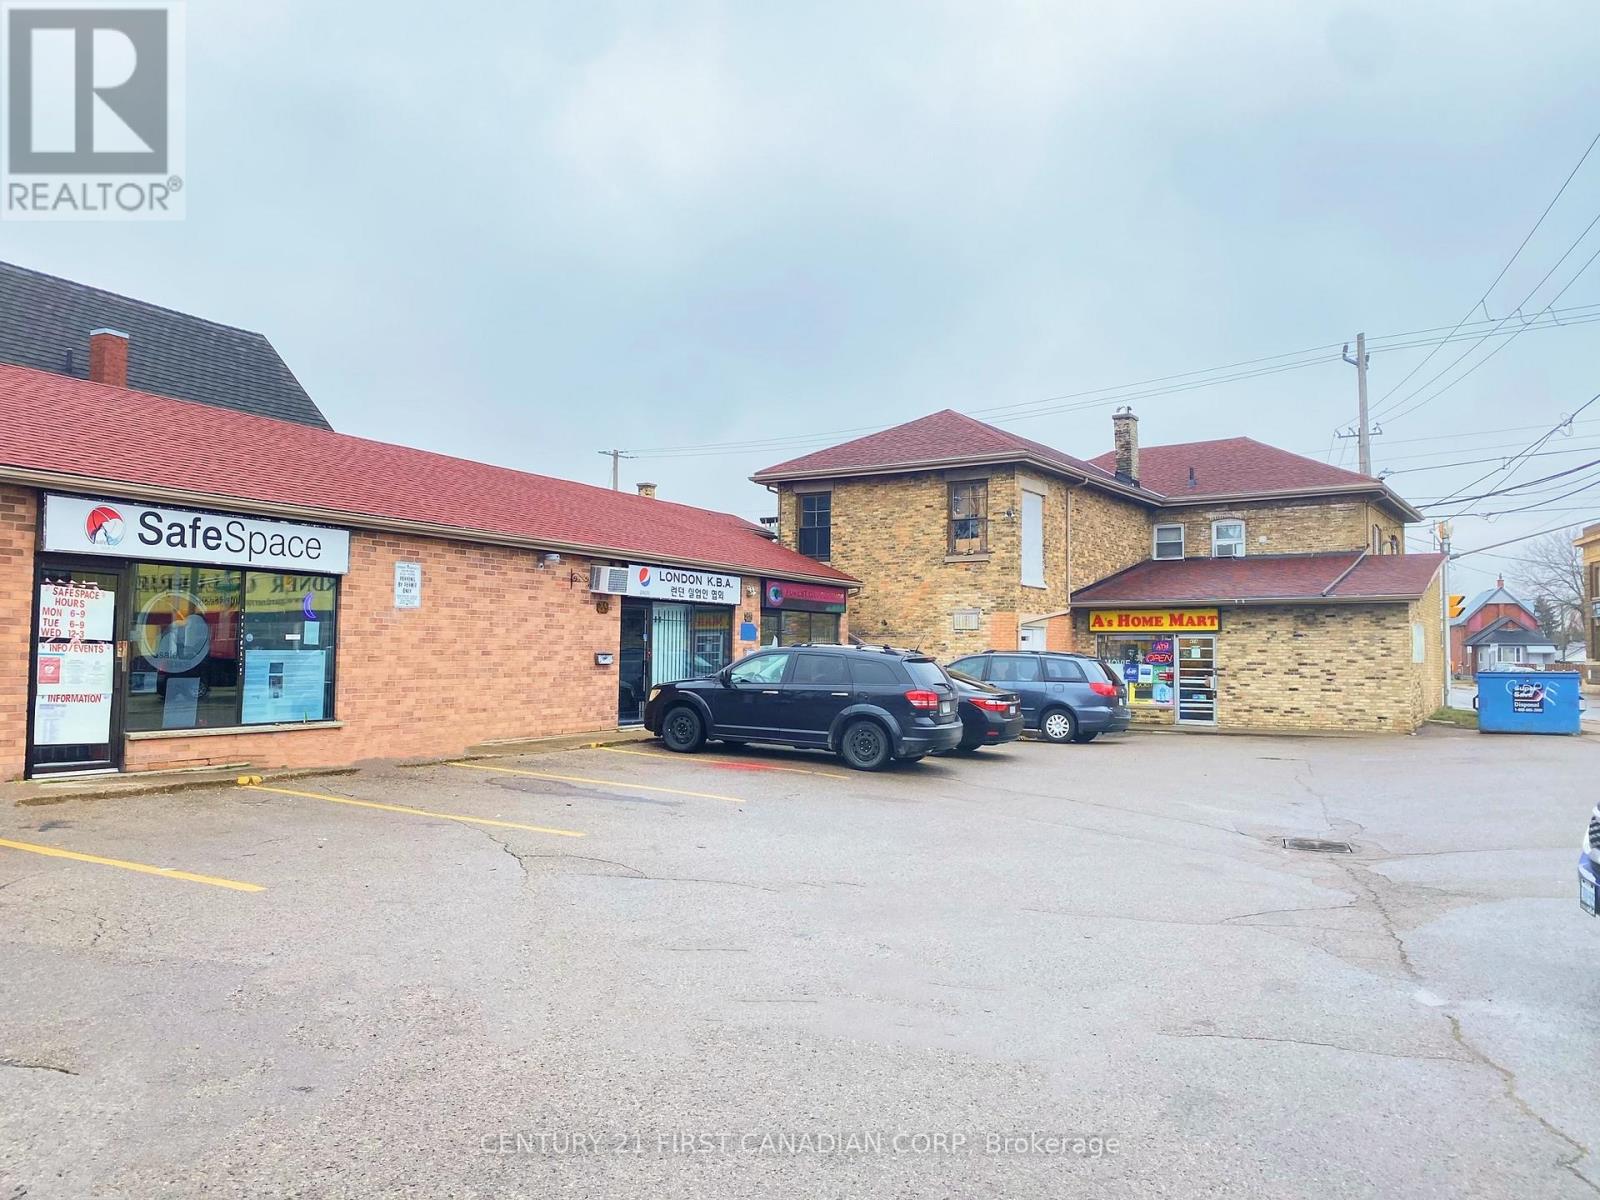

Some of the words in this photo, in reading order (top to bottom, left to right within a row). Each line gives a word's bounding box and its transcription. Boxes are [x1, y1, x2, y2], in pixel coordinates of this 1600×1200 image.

[138, 511, 321, 562] SafeSpace
[659, 571, 703, 585] LONDON
[707, 576, 734, 588] K.B.A.
[52, 586, 100, 600] SAFESPACE
[54, 597, 85, 608] HOURS
[42, 607, 62, 617] MON
[70, 610, 85, 618] 6-9
[43, 618, 59, 627] TUE
[69, 620, 85, 629] 6-9
[1117, 614, 1164, 627] HOME
[1168, 613, 1218, 627] MART
[41, 628, 61, 637] WED
[68, 630, 85, 638] 12-3
[1146, 654, 1173, 662] OPEN
[47, 694, 102, 703] INFORMATION
